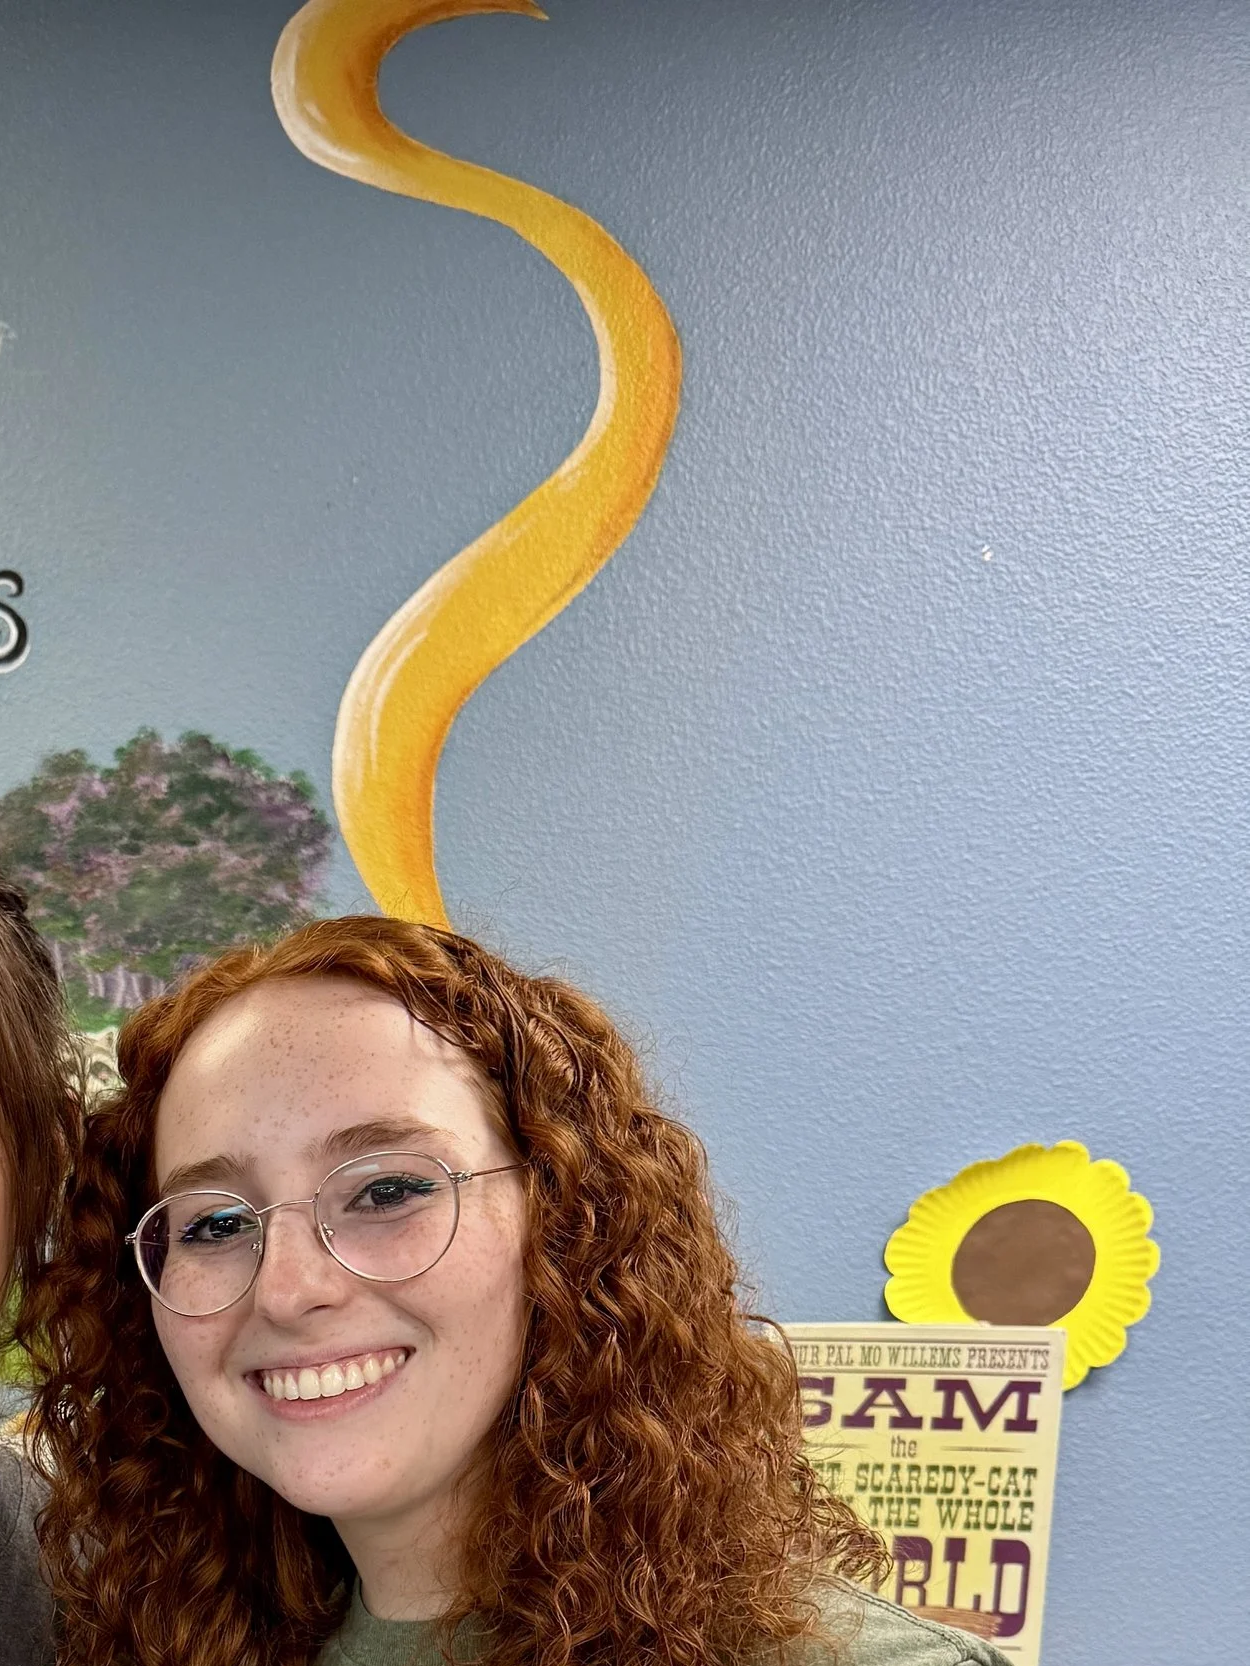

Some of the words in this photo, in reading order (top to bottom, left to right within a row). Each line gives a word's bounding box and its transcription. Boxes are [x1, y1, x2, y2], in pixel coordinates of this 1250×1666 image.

[826, 1345, 855, 1367] PAL
[859, 1345, 882, 1367] MO
[887, 1347, 962, 1369] WILLEMS
[966, 1348, 1050, 1371] PRESENTS
[798, 1376, 1042, 1432] SAM
[890, 1436, 918, 1458] the
[854, 1463, 1038, 1497] SCAREDY-CAT
[868, 1497, 922, 1528] THE
[936, 1499, 1036, 1532] WHOLE
[871, 1535, 1031, 1637] RLD
